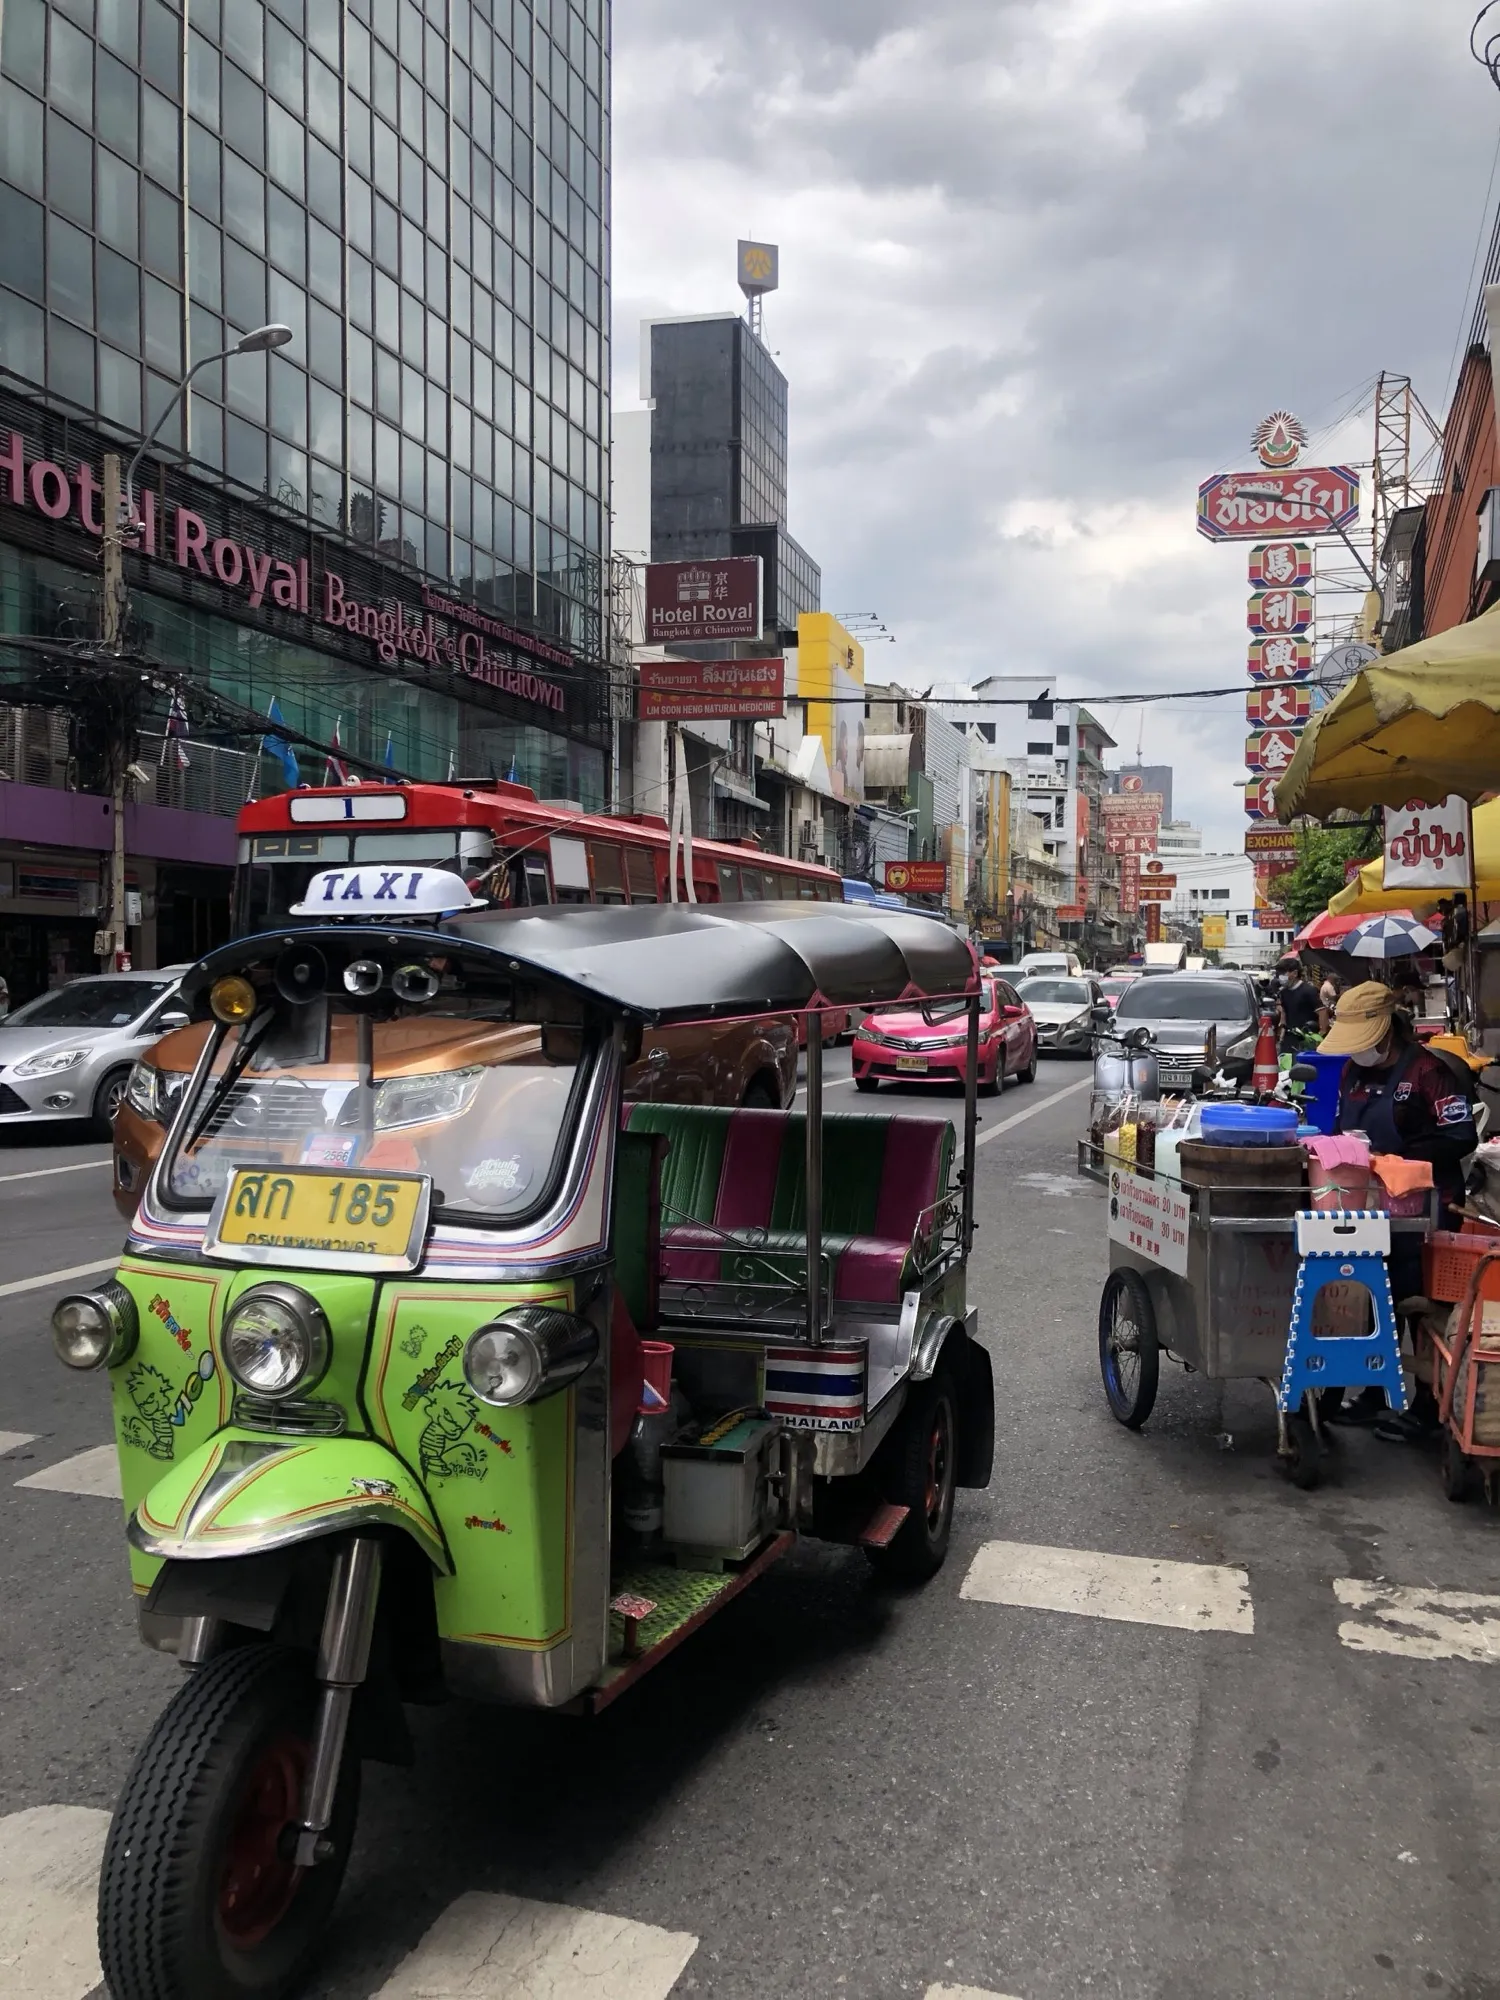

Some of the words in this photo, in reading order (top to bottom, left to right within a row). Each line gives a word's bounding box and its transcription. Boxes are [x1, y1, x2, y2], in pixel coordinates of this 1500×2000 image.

[175, 506, 308, 614] Royal
[652, 605, 697, 624] Hotel
[703, 602, 753, 621] Royal
[323, 570, 441, 663] Bangkok
[459, 632, 565, 712] Chinatown
[653, 626, 690, 639] Bangkok
[705, 625, 753, 635] Chinatown
[646, 705, 660, 715] LIM
[660, 705, 682, 714] SOON
[682, 704, 703, 714] HENG
[704, 703, 738, 713] NATURAL
[738, 702, 776, 712] MEDICINE
[342, 798, 355, 818] 1
[323, 873, 423, 900] TAXI
[324, 1151, 349, 1162] 2566
[235, 1173, 295, 1219] สก
[329, 1182, 400, 1227] 185
[1163, 1197, 1171, 1214] 20
[1174, 1203, 1186, 1221] บาท
[1161, 1222, 1170, 1239] 30
[1173, 1228, 1185, 1247] บาท
